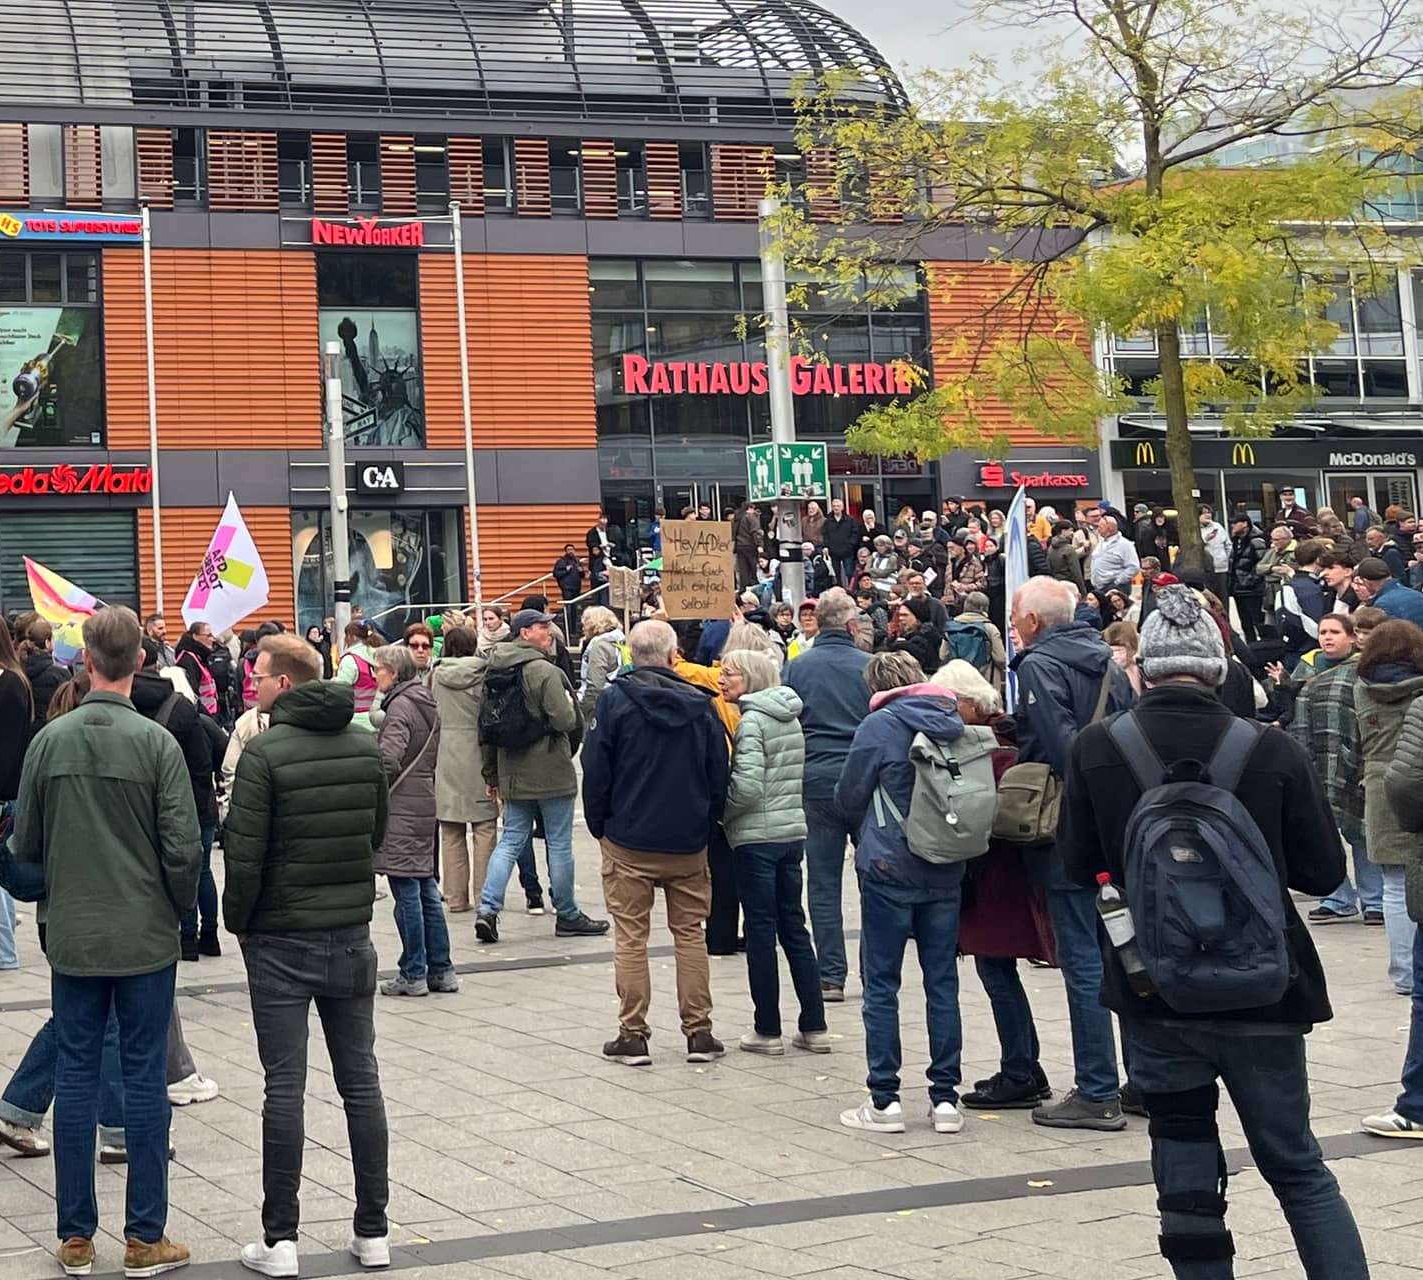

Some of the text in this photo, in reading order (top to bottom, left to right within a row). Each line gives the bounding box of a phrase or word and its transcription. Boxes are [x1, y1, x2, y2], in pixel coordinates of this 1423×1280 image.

[25, 219, 57, 233] TOYS
[1329, 452, 1417, 466] McDonald's
[75, 464, 154, 494] Markt
[1010, 471, 1088, 487] Sparkasse
[212, 549, 228, 572] AFD
